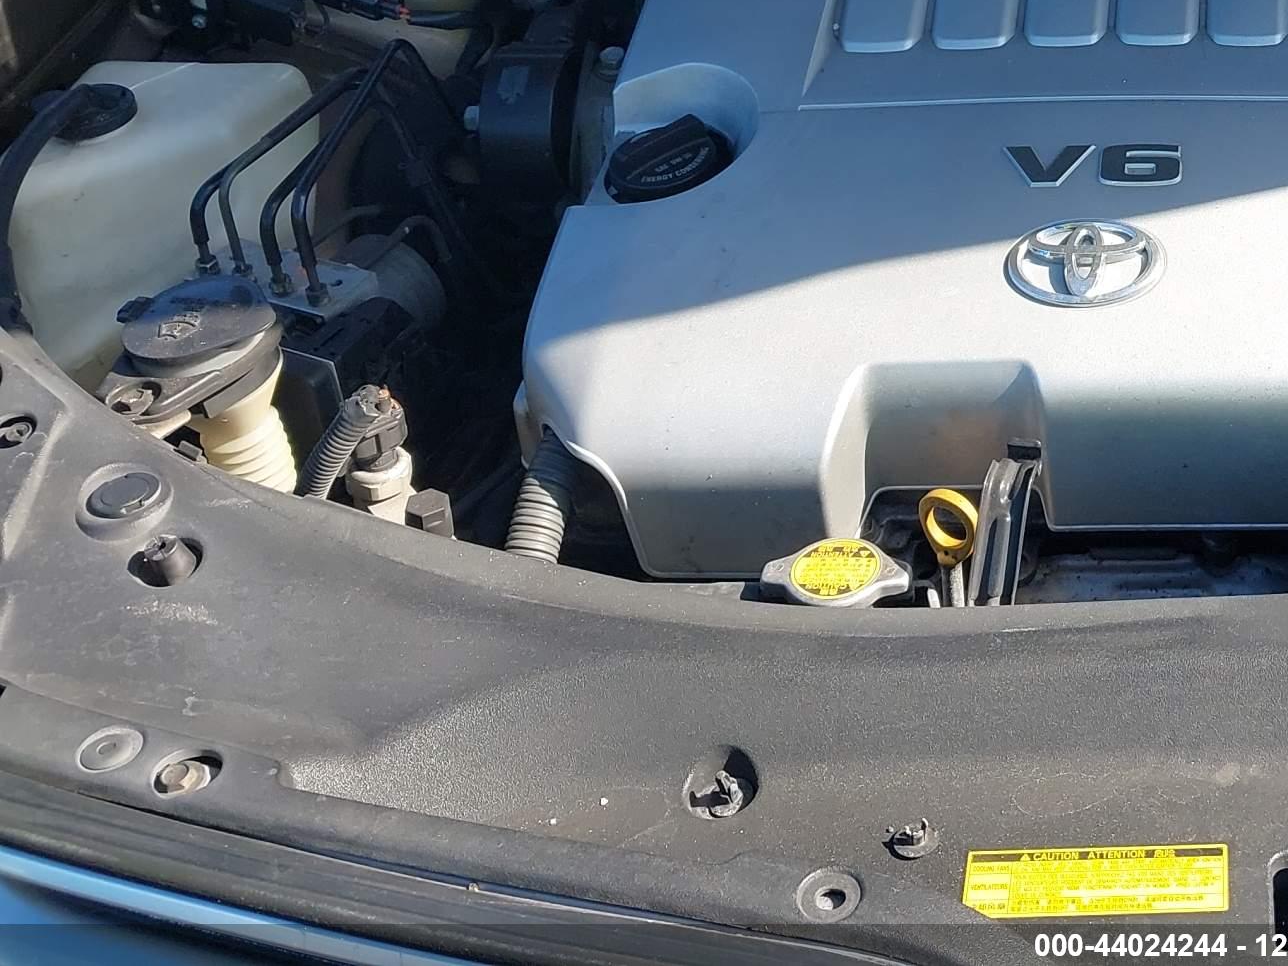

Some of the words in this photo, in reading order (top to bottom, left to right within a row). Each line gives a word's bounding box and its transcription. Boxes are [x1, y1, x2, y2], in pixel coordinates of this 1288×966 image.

[1003, 144, 1183, 187] V6
[641, 174, 673, 183] ENERGY
[1033, 852, 1079, 861] CAUTION
[1087, 849, 1145, 859] ATTENTION
